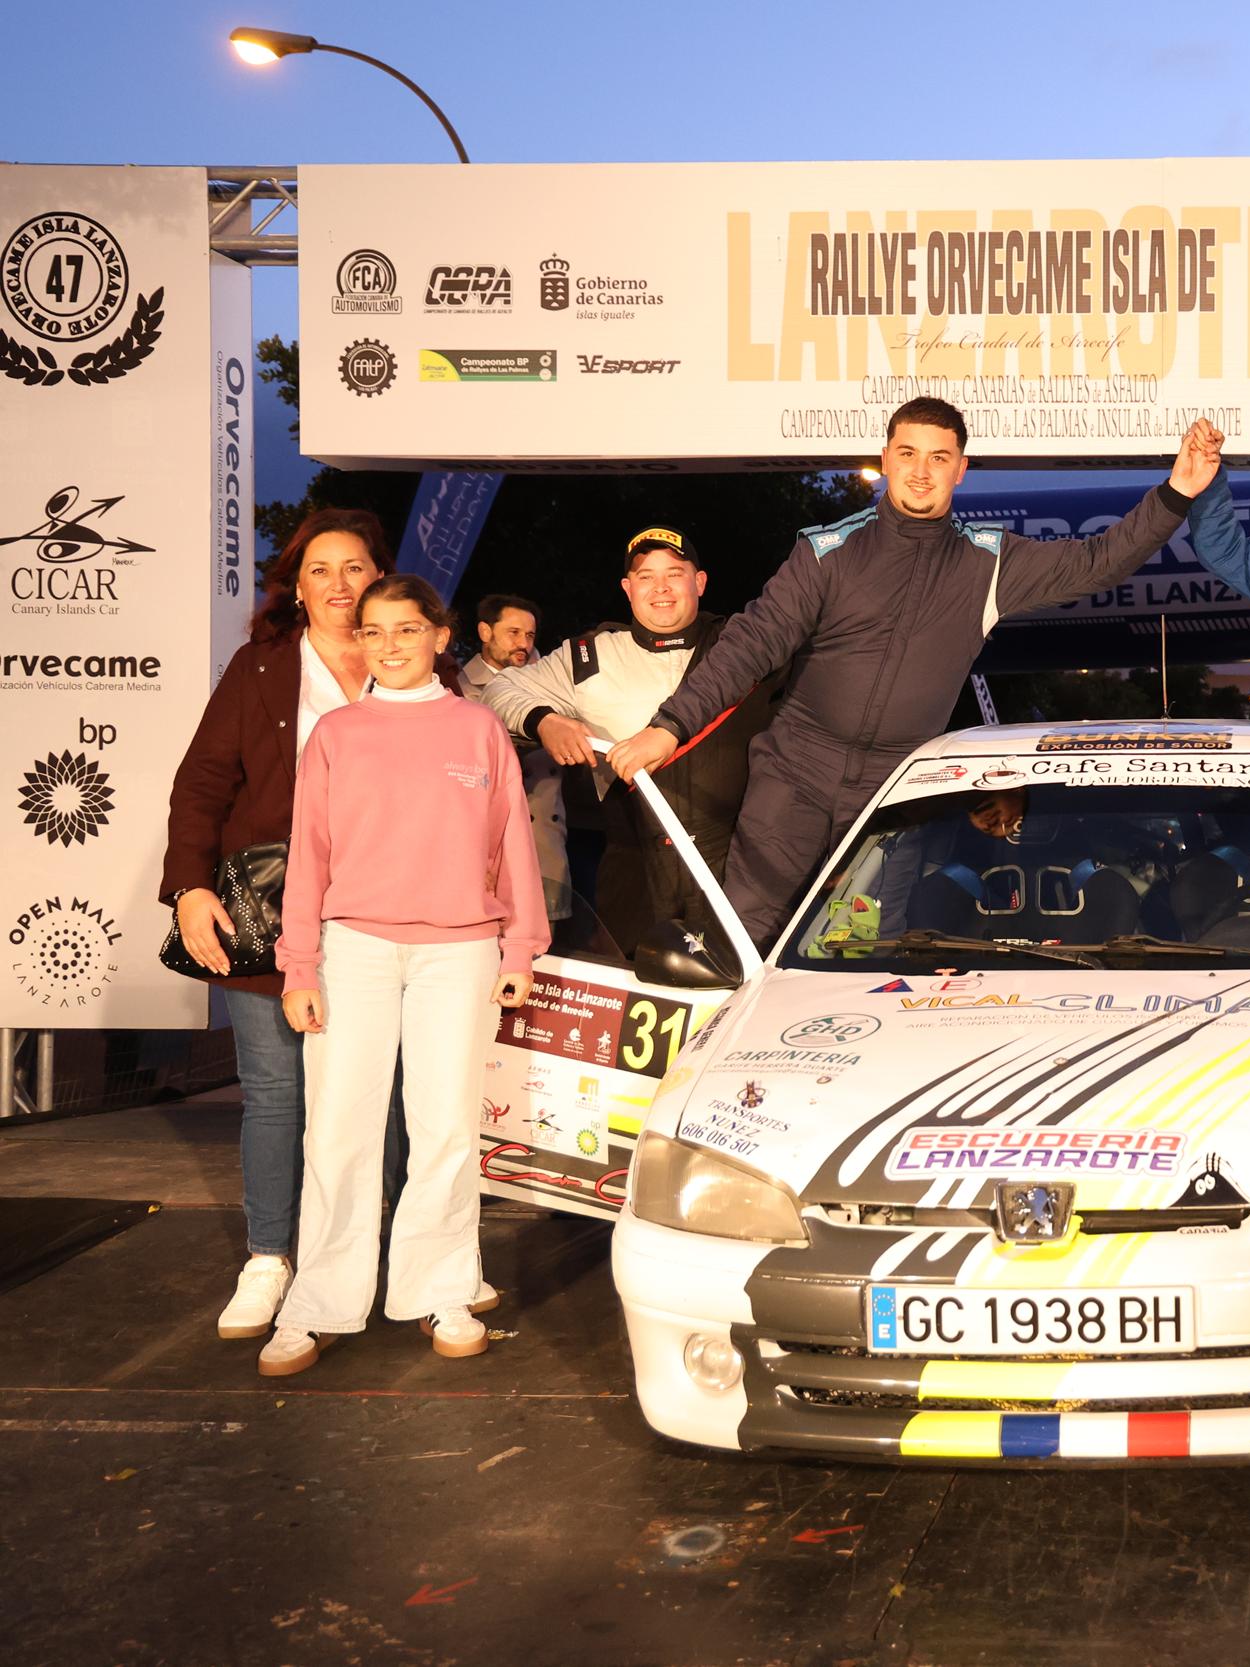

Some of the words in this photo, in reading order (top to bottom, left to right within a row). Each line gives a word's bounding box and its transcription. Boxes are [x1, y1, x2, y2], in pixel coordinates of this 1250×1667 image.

[32, 217, 82, 239] ISLA
[6, 234, 62, 335] ORVECAME
[46, 254, 84, 303] 47
[67, 225, 122, 336] LANZAROTE
[352, 265, 382, 291] FCA
[576, 276, 648, 290] Gobierno
[811, 231, 917, 316] RALLYE
[927, 229, 1092, 316] ORVECAME
[1103, 229, 1167, 313] ISLA
[1177, 228, 1215, 312] DE
[335, 299, 399, 312] AUTOMOVILISMO
[576, 292, 594, 305] de
[598, 292, 664, 305] Canarias
[576, 309, 598, 319] islas
[600, 309, 635, 321] iguales
[889, 327, 954, 364] Trofeo
[957, 331, 1026, 349] Ciudad
[1050, 325, 1131, 363] Arrecife
[461, 357, 515, 367] Campeonato
[517, 357, 530, 366] BP
[862, 375, 949, 405] CAMPEONATO
[962, 375, 1025, 404] CANARIAS
[1038, 375, 1090, 404] RALLYES
[1103, 374, 1158, 404] ASFALTO
[781, 409, 867, 439] CAMPEONATO
[1013, 409, 1037, 438] LAS
[1039, 408, 1088, 438] PALMAS
[1097, 408, 1150, 437] INSULAR
[225, 357, 245, 597] Orvecame
[974, 533, 997, 543] OMP
[11, 567, 119, 600] CICAR
[1089, 583, 1136, 608] DE
[11, 603, 52, 617] Canary
[56, 603, 96, 615] Islands
[99, 603, 120, 615] Car
[0, 655, 161, 678] rvecame
[36, 681, 83, 691] Vehículos
[85, 681, 123, 691] Cabrera
[126, 681, 161, 691] Medina
[79, 717, 117, 750] bp
[1041, 742, 1138, 750] EXPLOSIÓN
[1031, 758, 1112, 775] Cafe
[9, 896, 62, 945] OPEN
[71, 896, 123, 946] MALL
[12, 962, 119, 1008] LANZAROTE
[545, 983, 561, 997] Isla
[562, 987, 574, 1001] de
[576, 989, 622, 1011] Lanzarote
[550, 1002, 561, 1011] de
[562, 1003, 594, 1018] Arrecife
[622, 1000, 687, 1077] 31
[801, 1024, 863, 1035] GHD
[724, 1050, 862, 1066] CARPINTERÍA
[708, 1099, 791, 1132] TRANSPORTES
[682, 1122, 708, 1139] 606
[706, 1129, 732, 1147] 016
[729, 1138, 760, 1155] 507
[909, 1131, 1183, 1151] ESCUDERÍA
[896, 1149, 1178, 1172] LANZAROTE
[878, 1323, 890, 1339] E
[903, 1296, 964, 1343] GC
[984, 1296, 1106, 1344] 1938
[1120, 1296, 1181, 1343] BH
